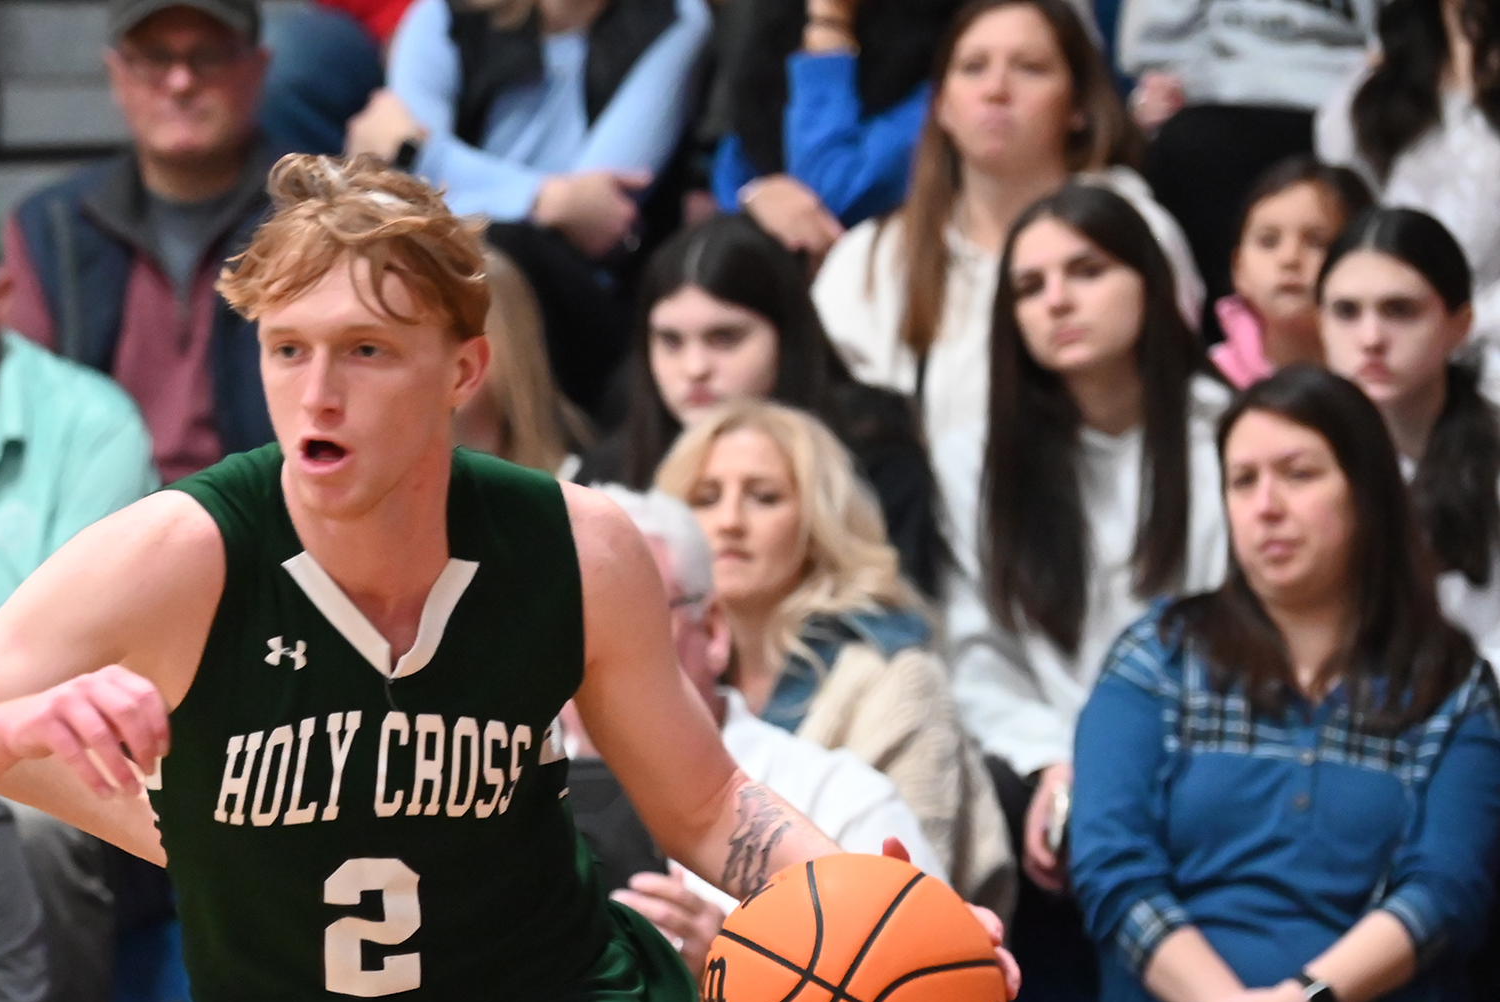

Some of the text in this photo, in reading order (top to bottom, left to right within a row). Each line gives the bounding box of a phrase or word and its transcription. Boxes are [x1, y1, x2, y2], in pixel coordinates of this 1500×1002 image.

[214, 710, 532, 827] HOLY CROSS
[324, 857, 421, 998] 2
